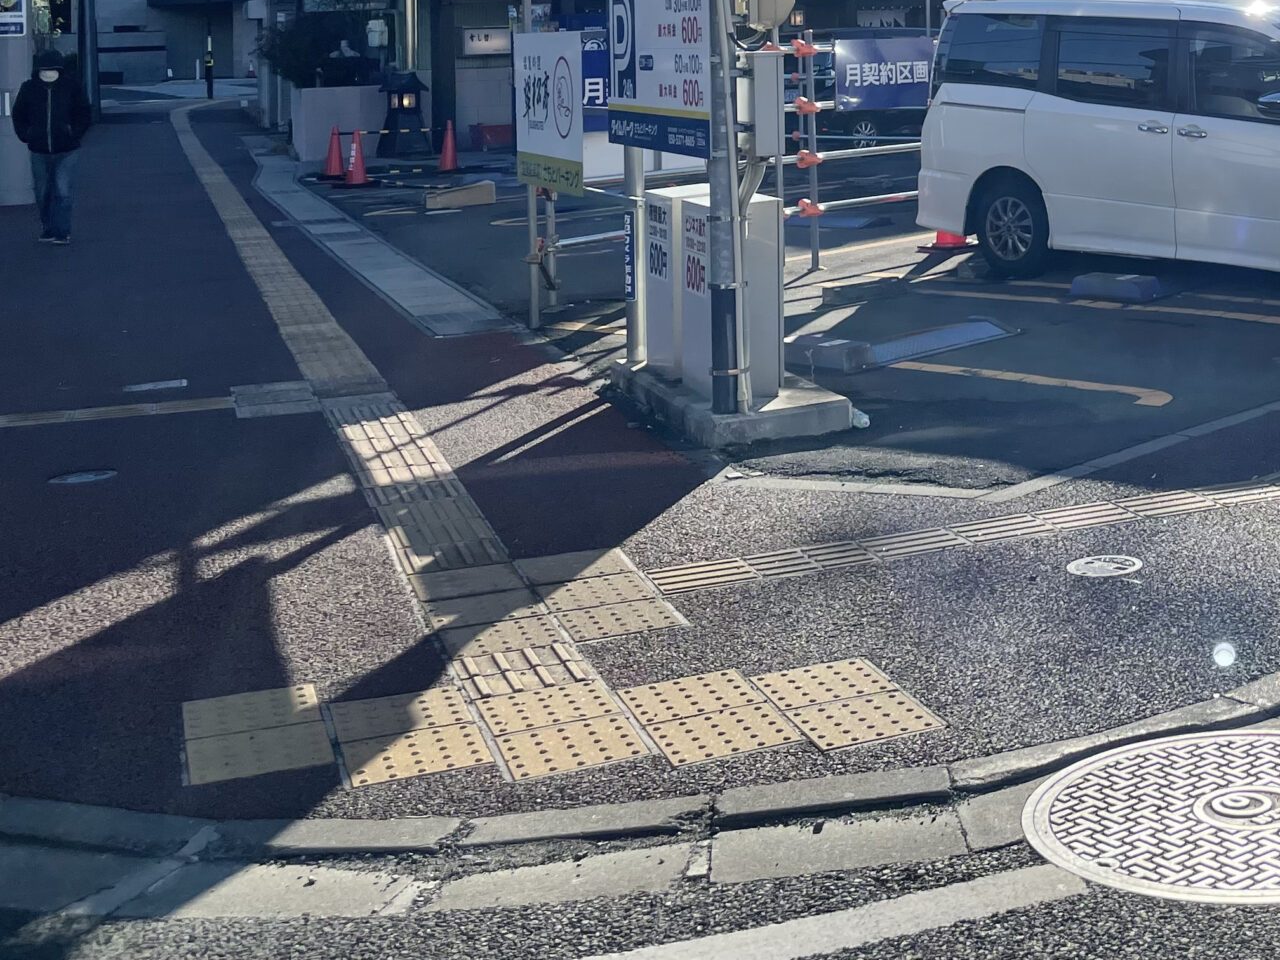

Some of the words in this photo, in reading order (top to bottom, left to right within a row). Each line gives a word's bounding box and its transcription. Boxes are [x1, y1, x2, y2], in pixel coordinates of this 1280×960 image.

[845, 60, 929, 87] 月契約区画
[649, 242, 668, 280] 600円
[686, 254, 706, 295] 600円
